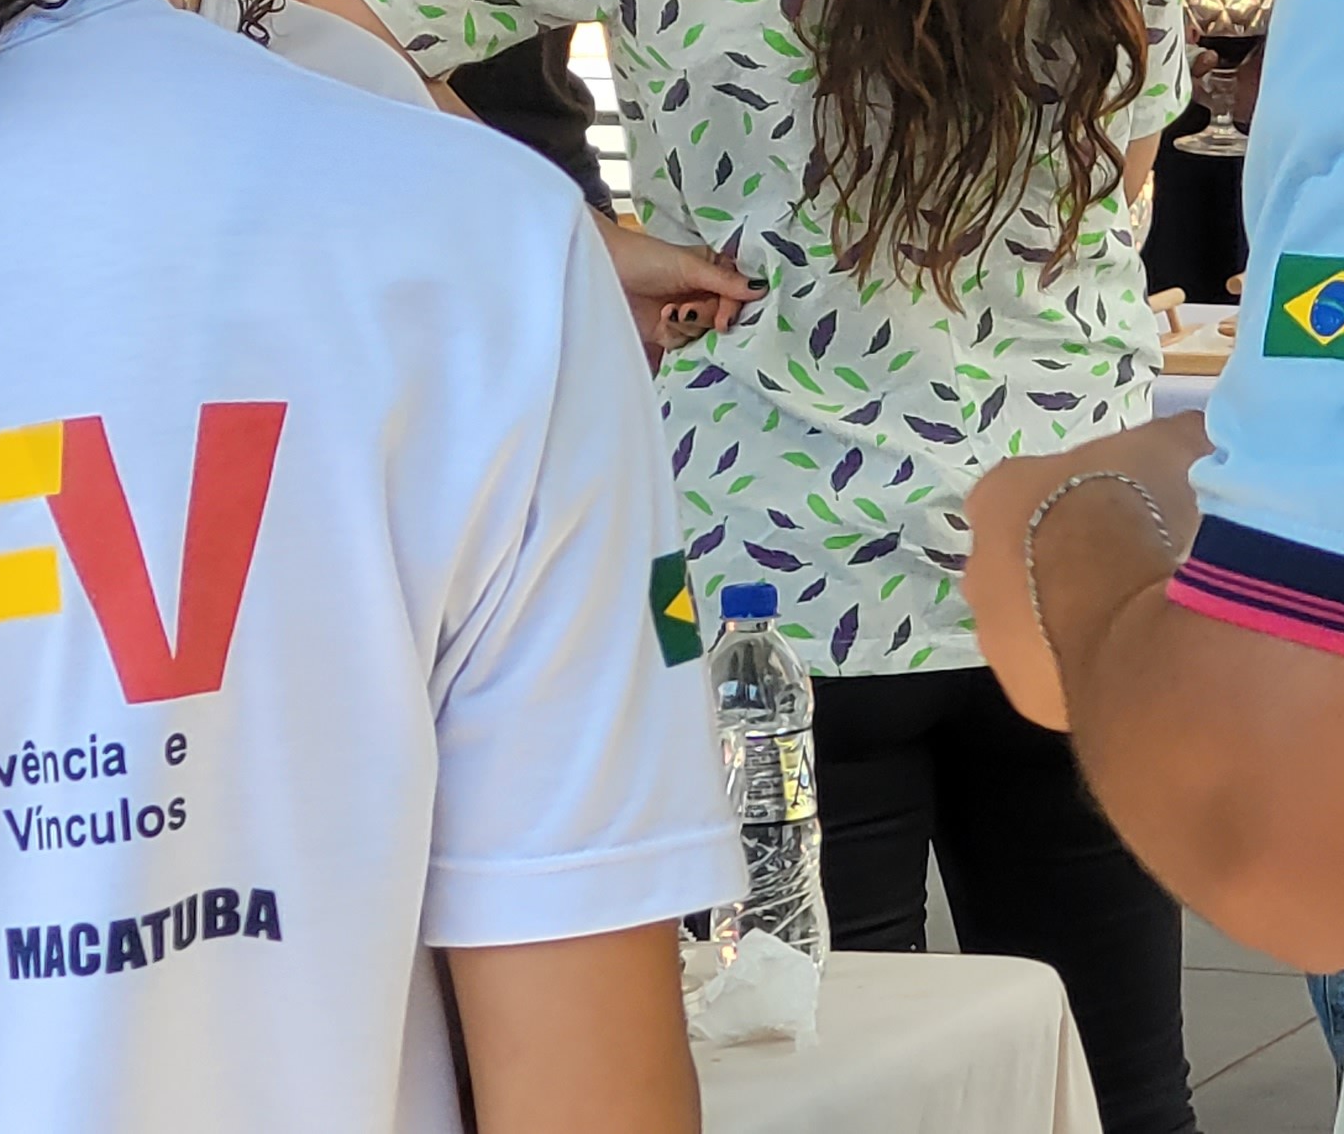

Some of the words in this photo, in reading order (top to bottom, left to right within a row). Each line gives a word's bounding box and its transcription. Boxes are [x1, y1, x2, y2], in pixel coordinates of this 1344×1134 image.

[164, 731, 188, 766] e
[3, 796, 188, 852] Vínculos
[5, 888, 284, 981] MACATUBA
